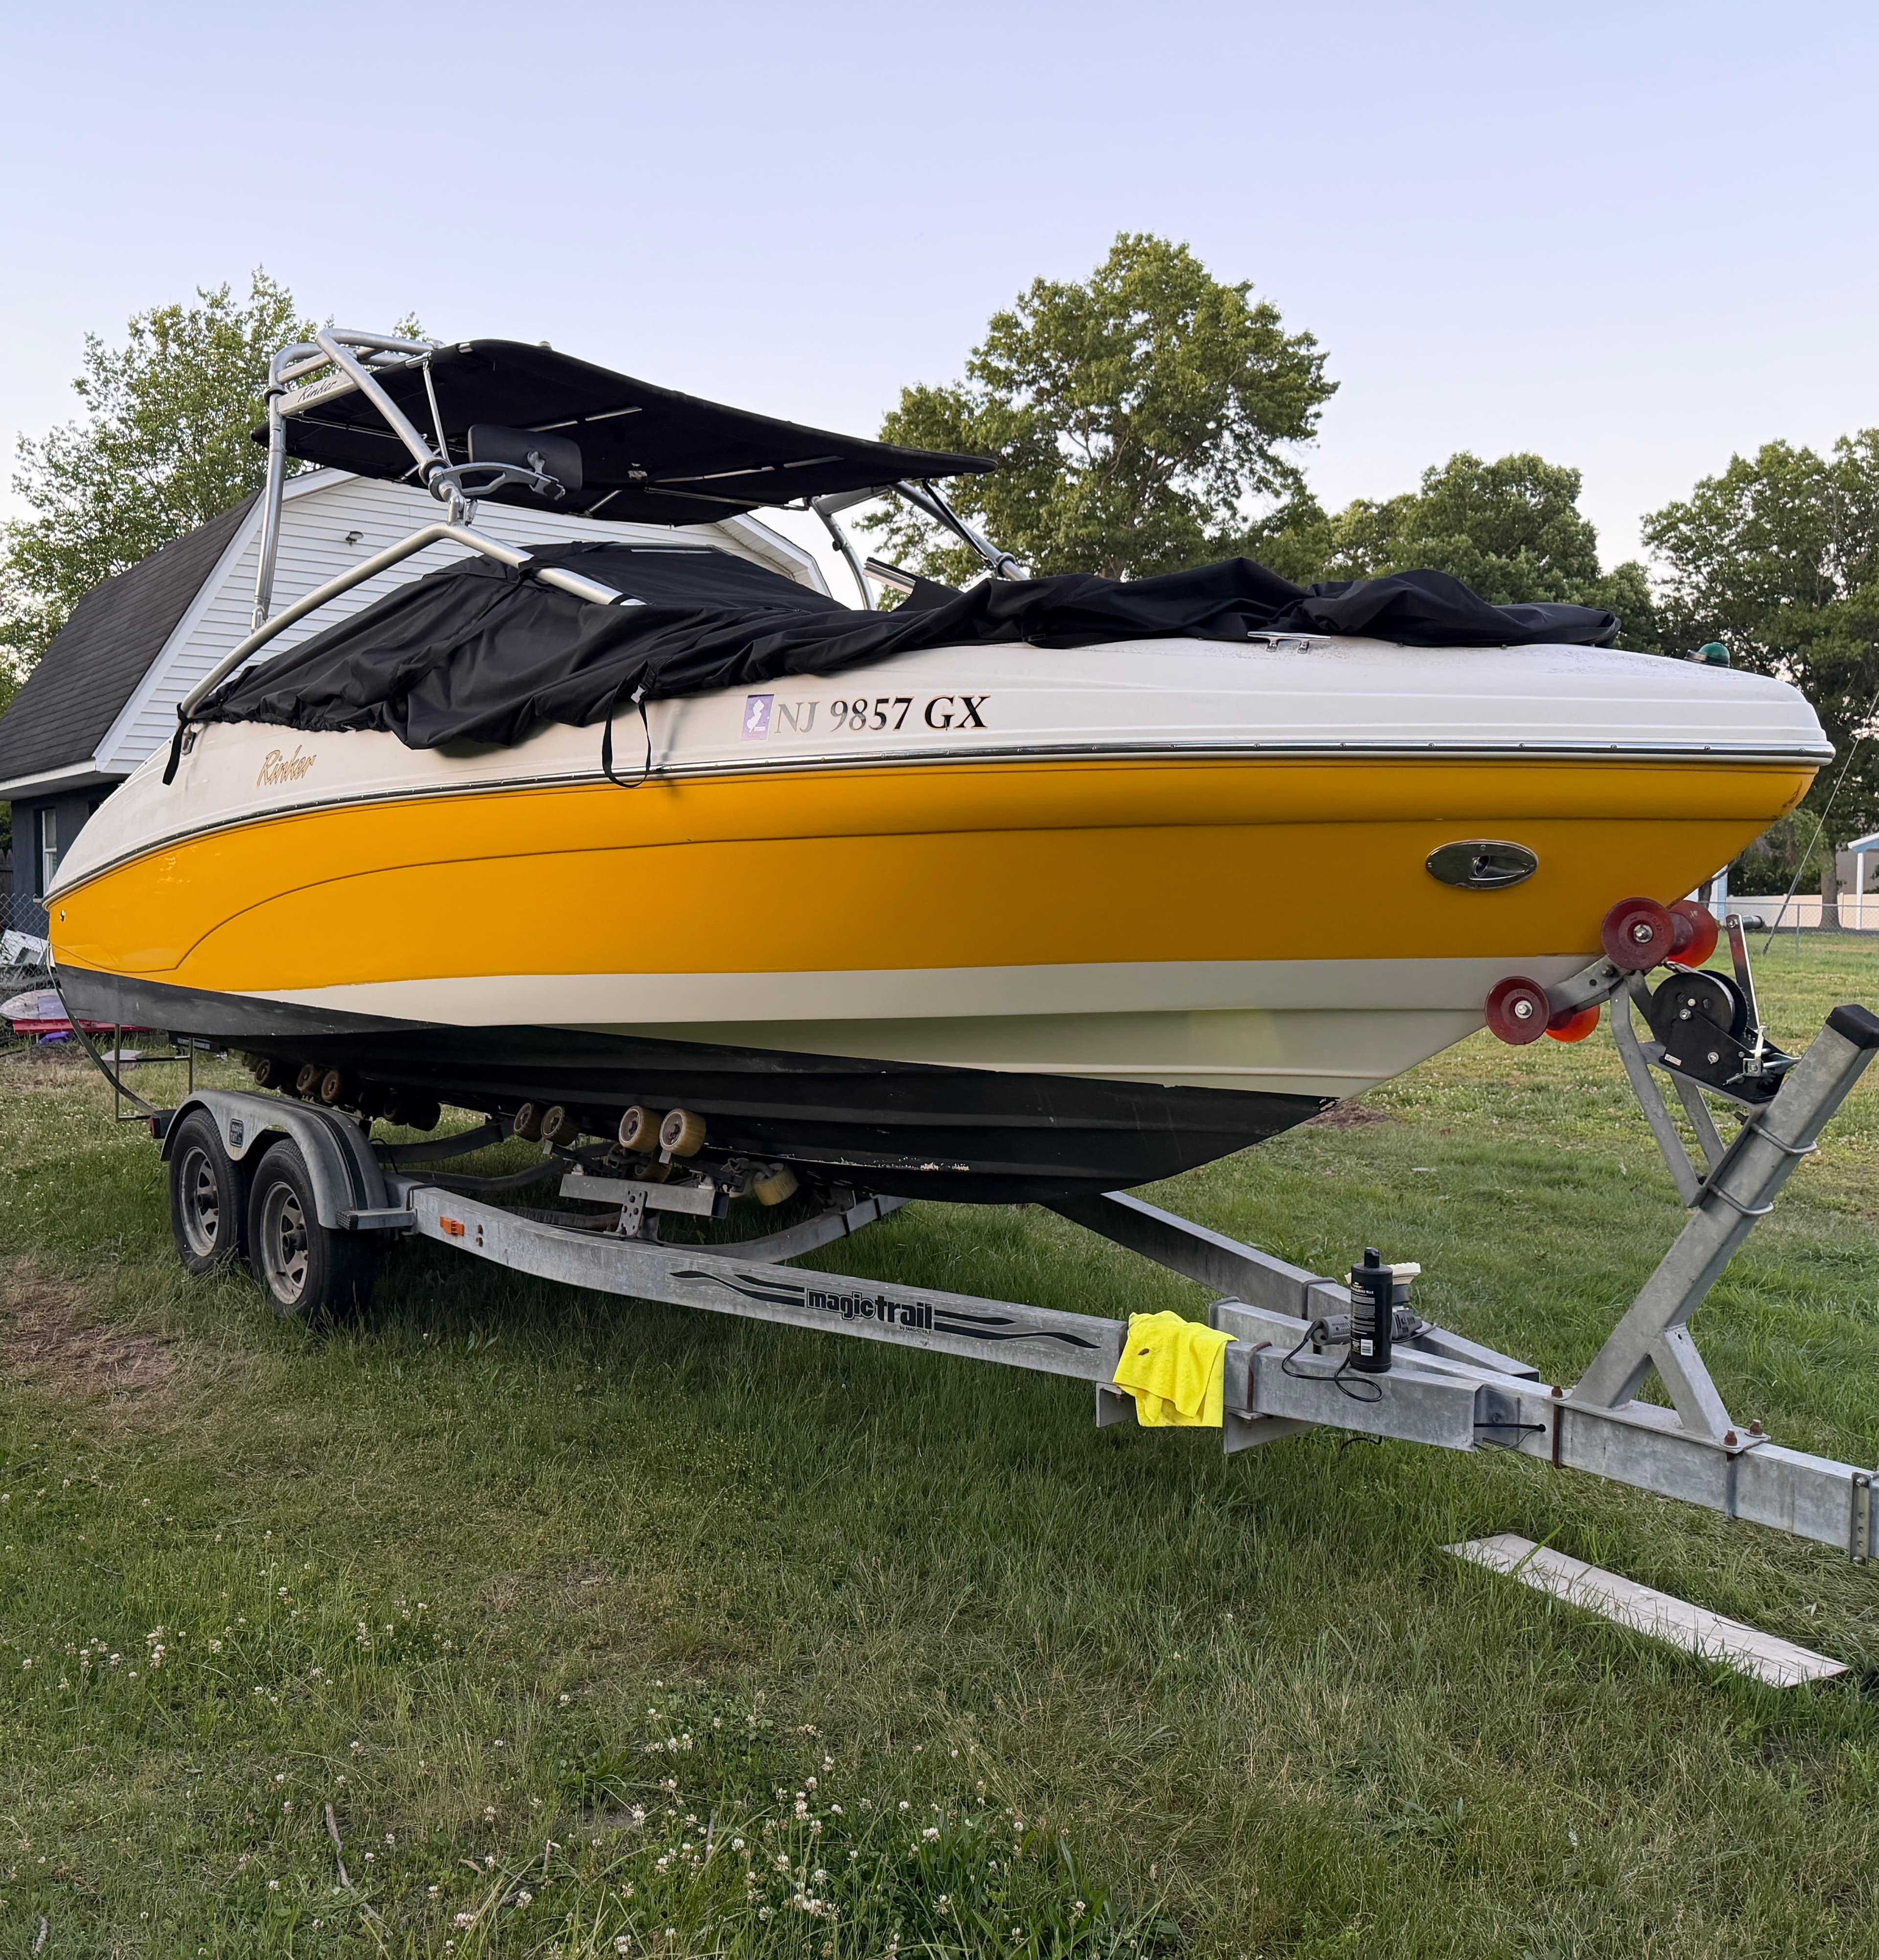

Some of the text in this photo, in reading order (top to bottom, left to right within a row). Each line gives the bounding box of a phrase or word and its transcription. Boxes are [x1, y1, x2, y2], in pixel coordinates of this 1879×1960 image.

[298, 380, 337, 403] Rinker
[775, 695, 991, 733] NJ 9857 GX
[256, 744, 317, 787] Rinker
